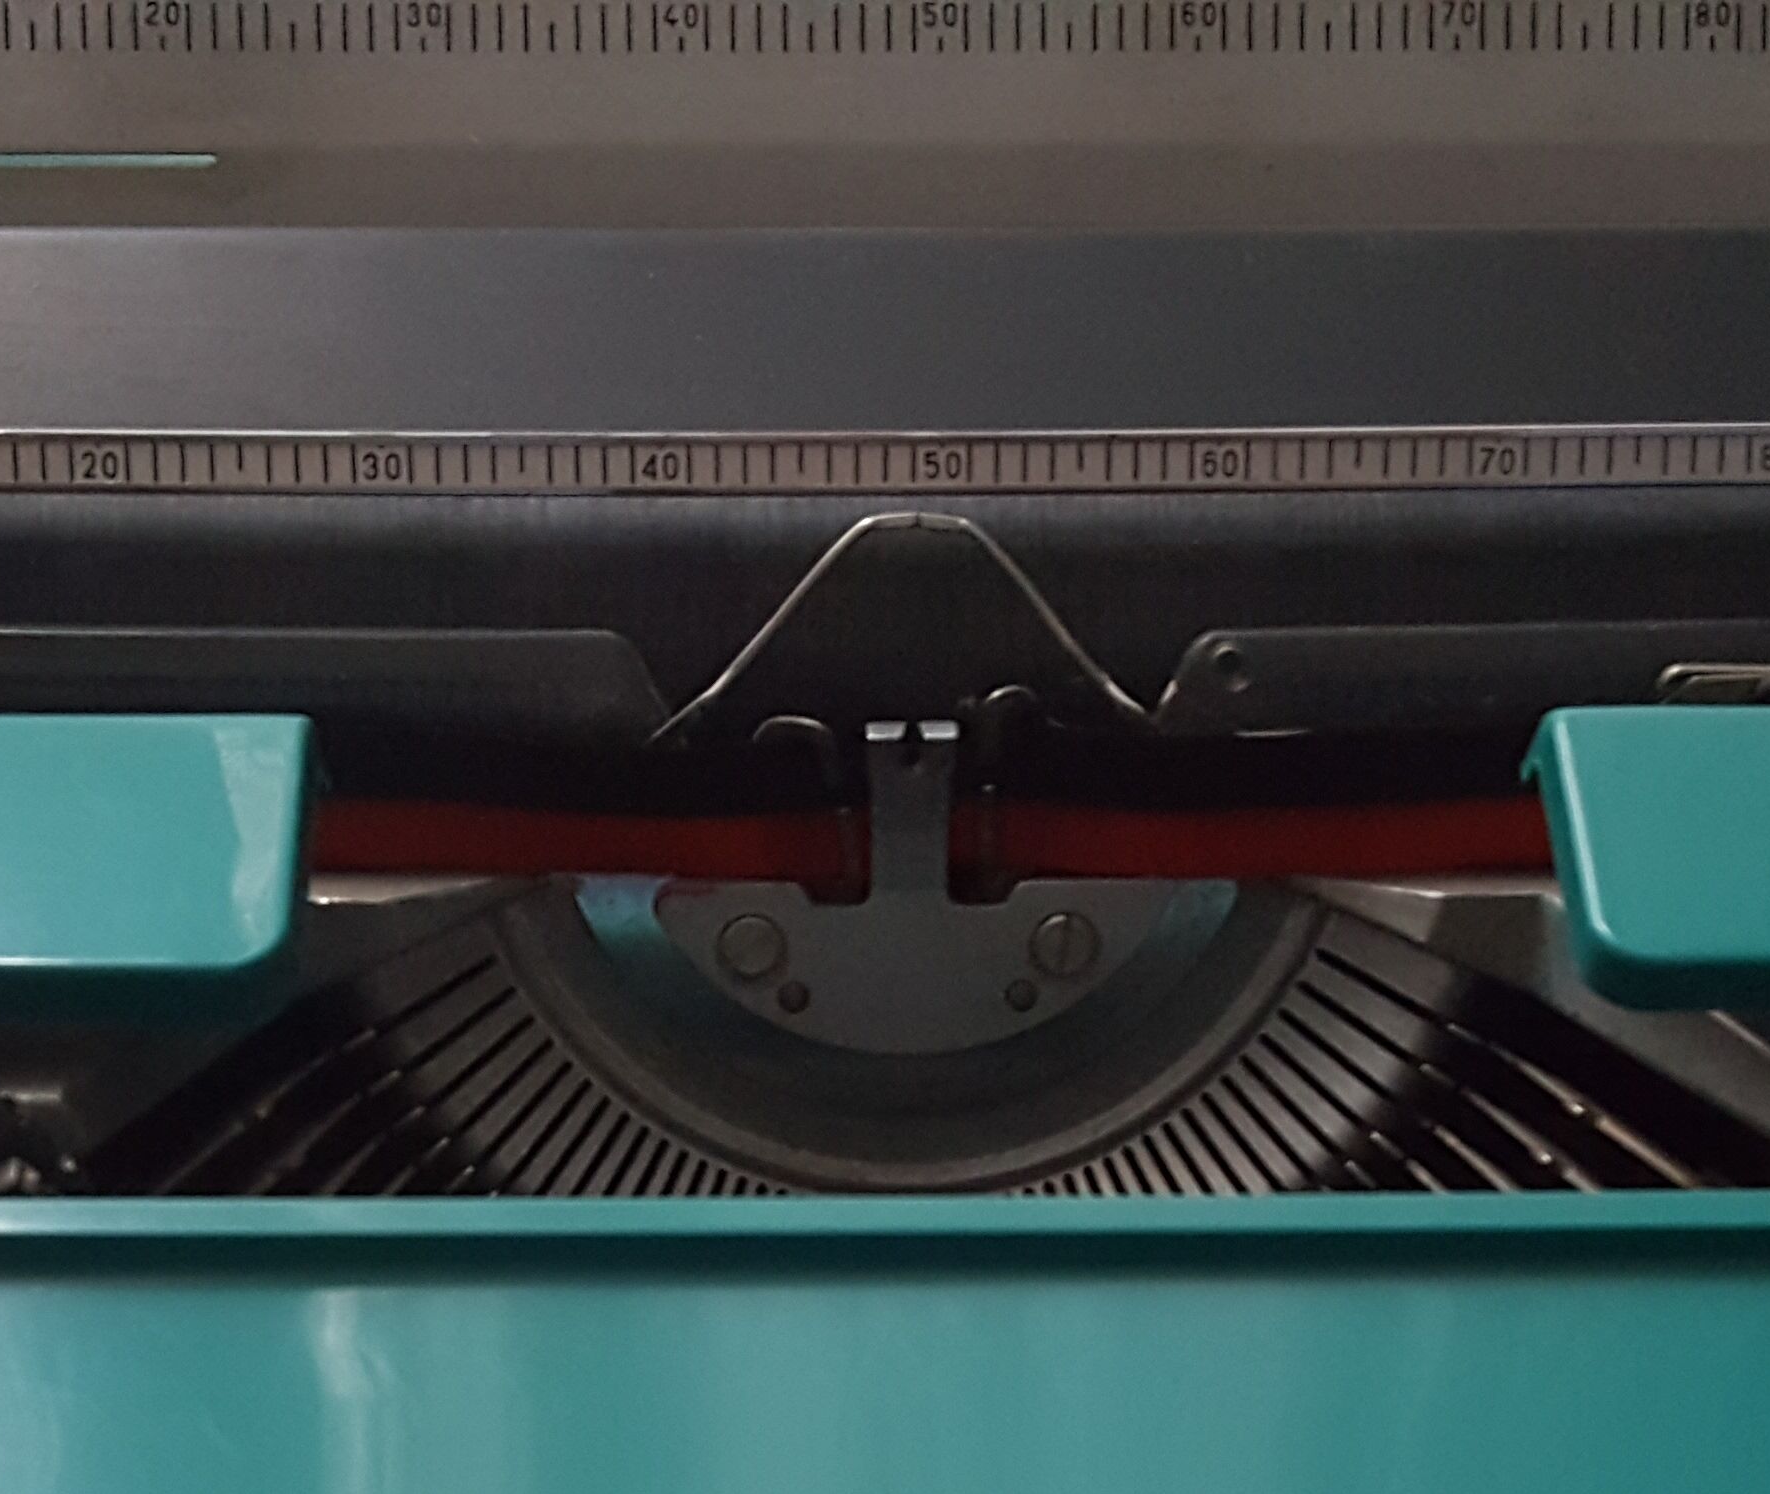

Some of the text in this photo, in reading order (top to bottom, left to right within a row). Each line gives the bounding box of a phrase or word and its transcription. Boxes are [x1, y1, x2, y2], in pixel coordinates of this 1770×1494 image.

[144, 2, 181, 28] 20
[407, 2, 443, 28] 30
[663, 2, 699, 29] 40
[923, 2, 959, 28] 50
[1181, 2, 1217, 28] 60
[1441, 2, 1477, 28] 70
[1694, 2, 1730, 28] 80
[78, 448, 122, 481] 20
[360, 448, 402, 481] 30
[639, 448, 682, 482] 40
[920, 447, 962, 480] 50
[1199, 445, 1241, 479] 60
[1477, 444, 1520, 478] 70
